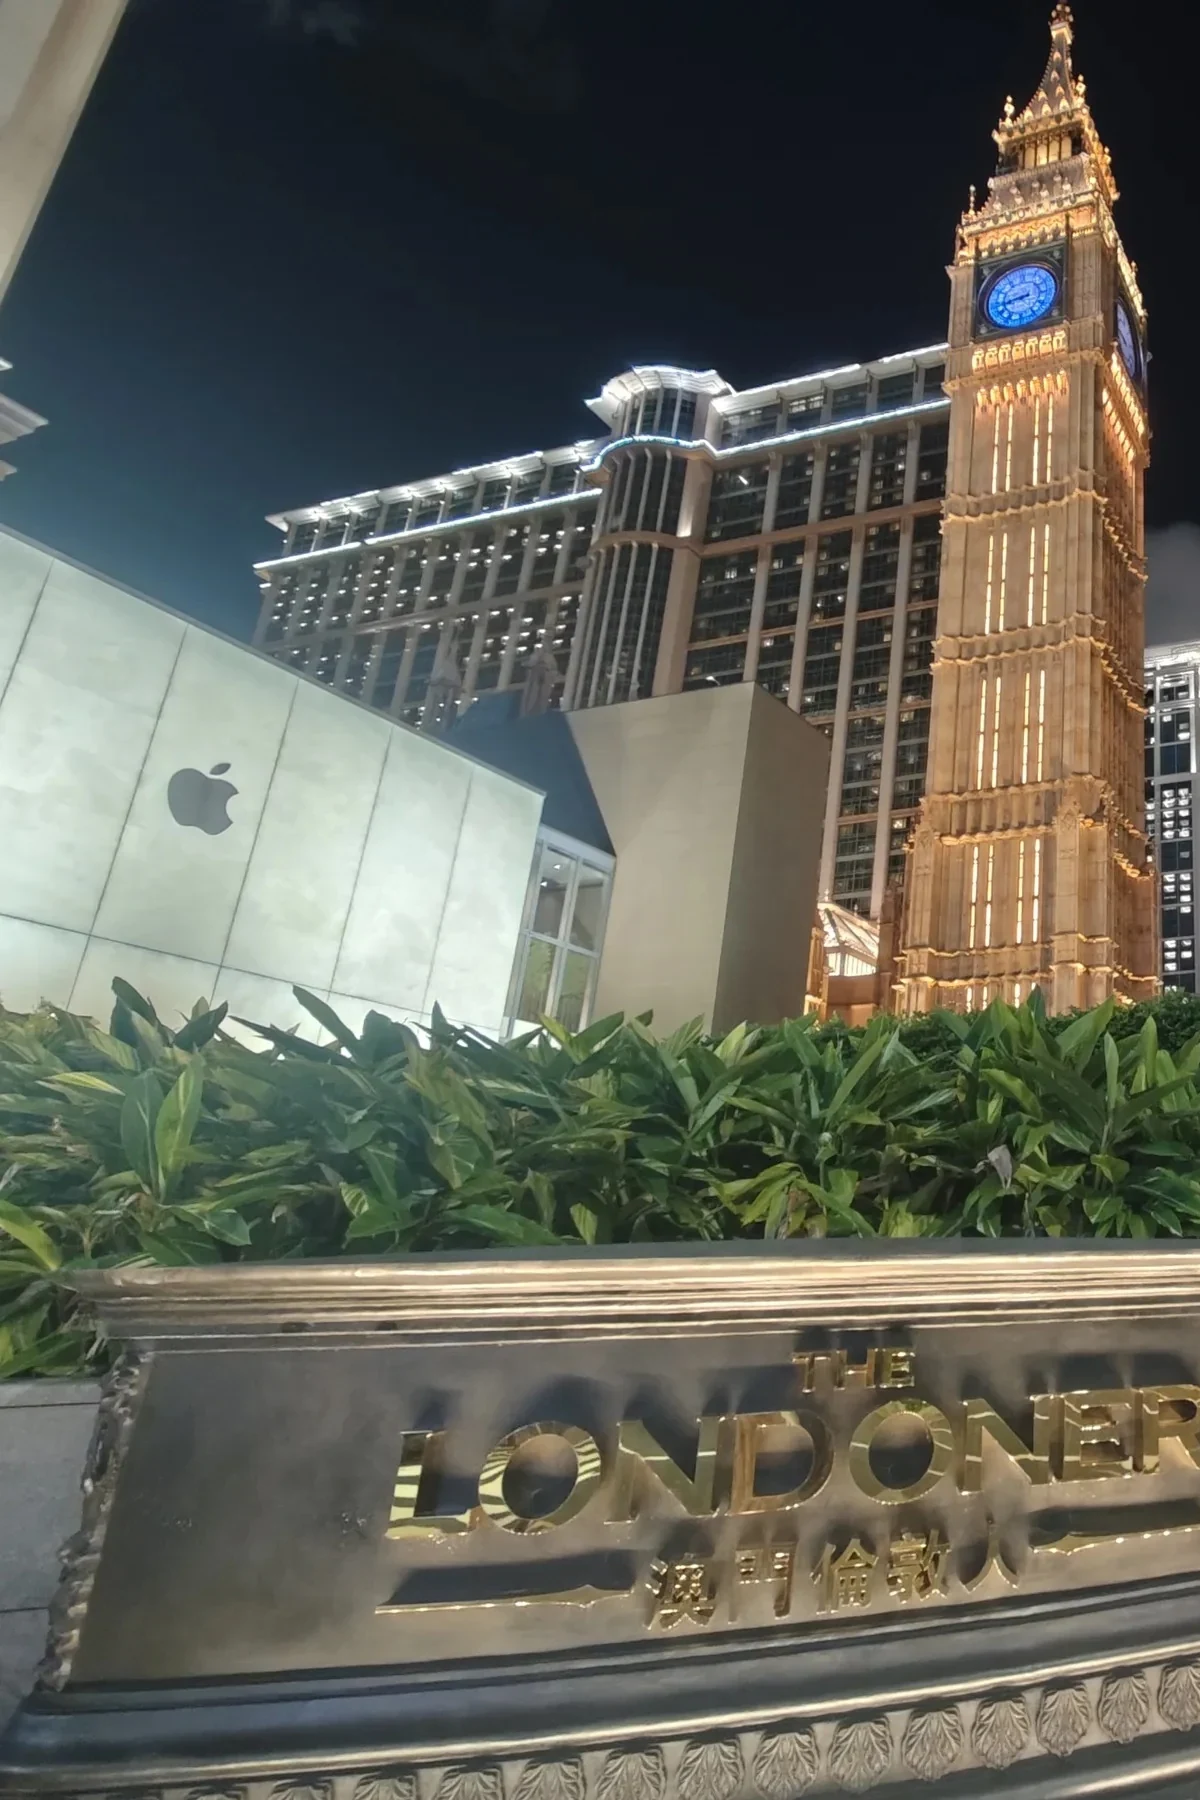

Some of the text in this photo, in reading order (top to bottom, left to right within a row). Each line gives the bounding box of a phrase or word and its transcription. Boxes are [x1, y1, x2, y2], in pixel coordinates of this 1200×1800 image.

[792, 1347, 916, 1393] THE
[643, 1518, 1020, 1631] 澳門倫敦人
